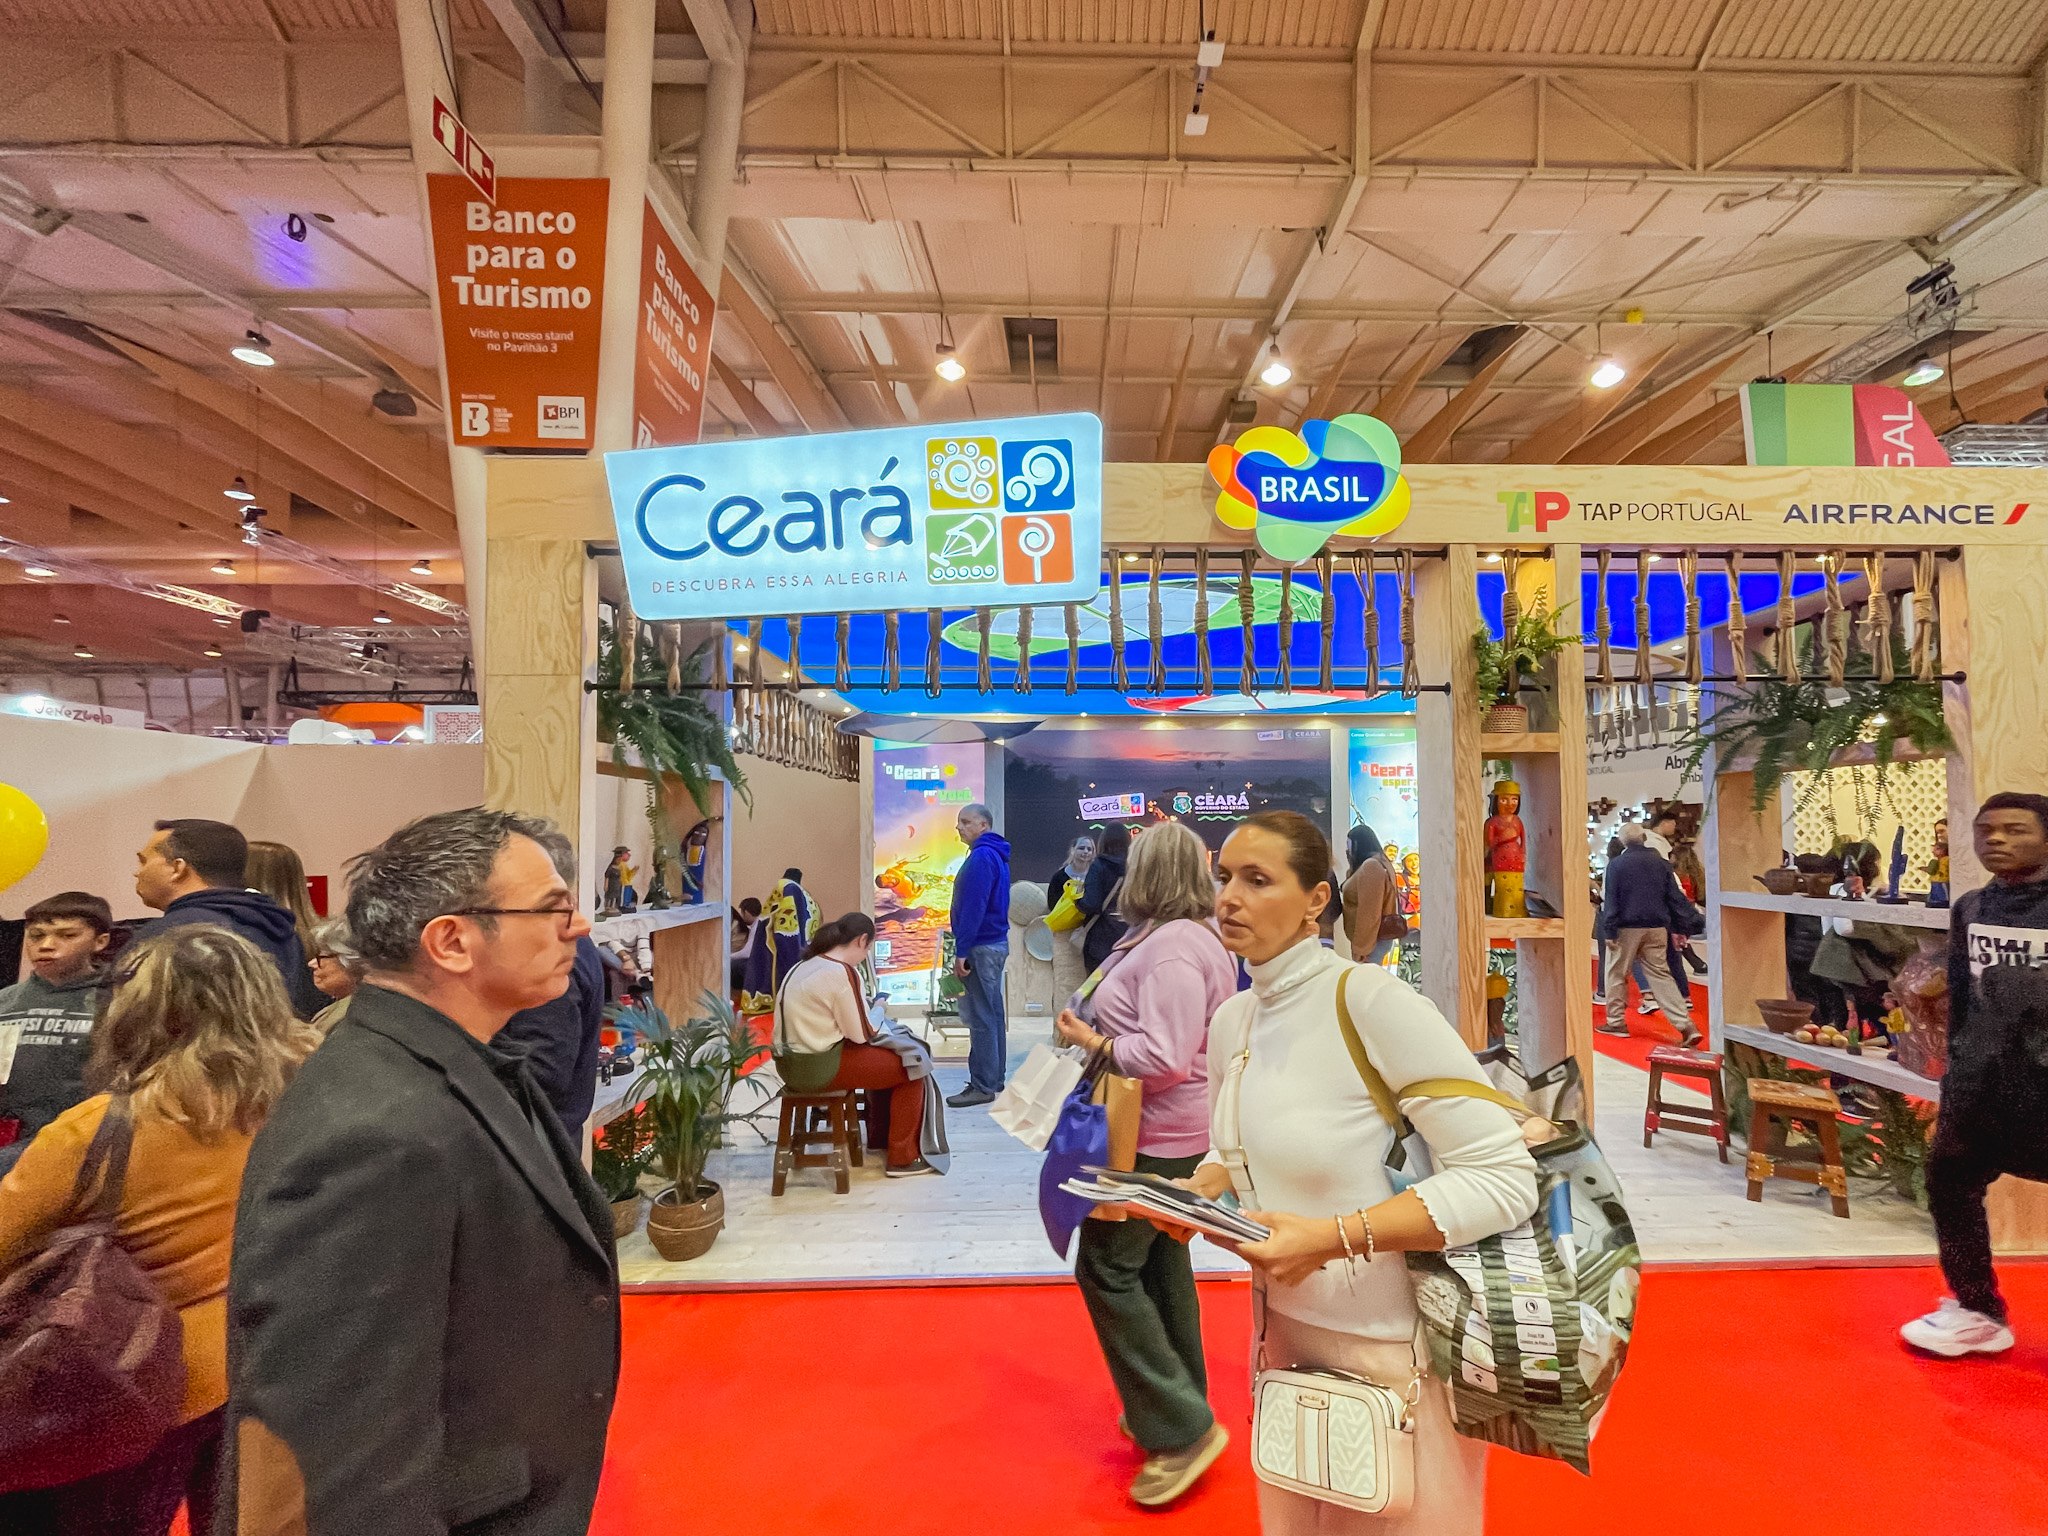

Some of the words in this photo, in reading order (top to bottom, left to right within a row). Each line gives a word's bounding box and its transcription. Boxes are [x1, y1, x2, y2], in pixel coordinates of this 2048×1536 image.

[467, 202, 576, 234] Banco
[467, 244, 545, 273] para
[556, 247, 577, 270] o
[451, 276, 591, 309] Turismo
[655, 244, 699, 325] Banco
[653, 281, 684, 340] para
[687, 332, 697, 354] o
[469, 327, 500, 339] Visite
[502, 331, 510, 339] o
[512, 331, 542, 340] nosso
[545, 331, 574, 341] stand
[487, 342, 500, 351] no
[503, 342, 549, 353] Pavilhão
[551, 343, 558, 353] 3
[645, 301, 700, 391] Turismo
[559, 407, 579, 419] BPI
[1260, 476, 1370, 503] BRASIL
[634, 455, 913, 561] Ceará
[1497, 491, 1571, 532] TAP
[1577, 503, 1622, 521] TAP
[1627, 503, 1753, 521] PORTUGAL
[1783, 503, 1995, 525] AIRFRANCE
[652, 577, 756, 594] DESCUBRA
[766, 575, 813, 588] ESSA
[824, 571, 908, 585] ALEGRIA
[894, 764, 940, 780] Ceará
[1370, 763, 1414, 777] Ceará
[1083, 799, 1119, 813] Ceará
[1194, 791, 1250, 806] CEARÁ
